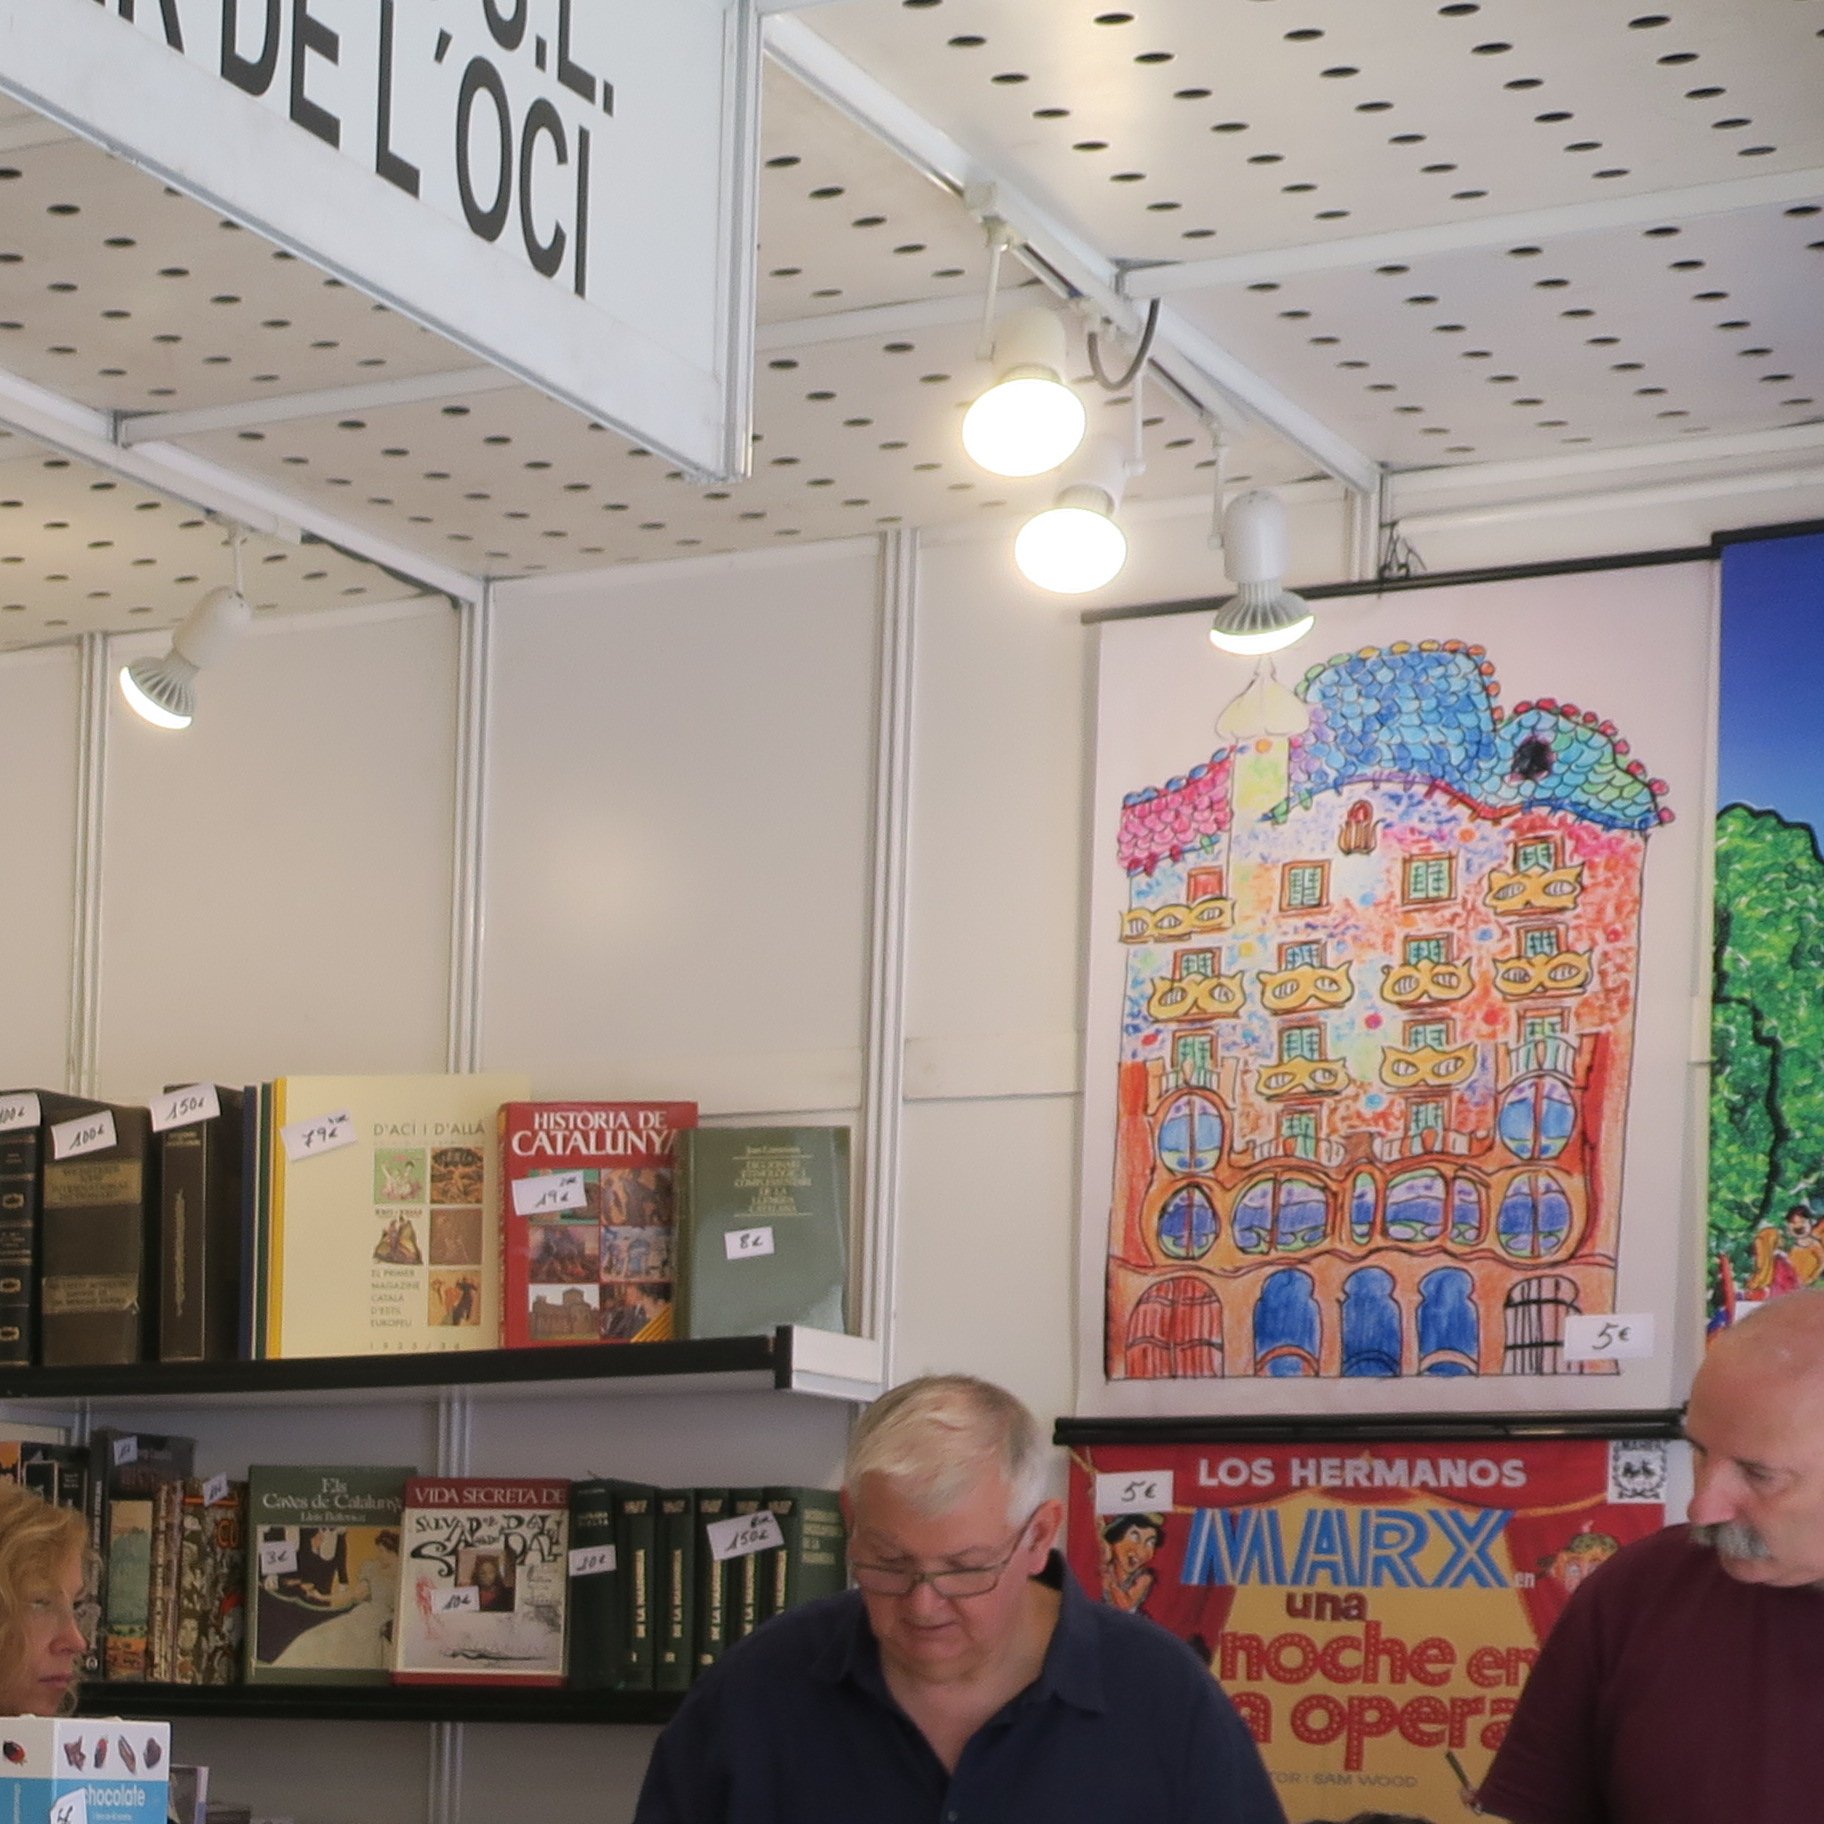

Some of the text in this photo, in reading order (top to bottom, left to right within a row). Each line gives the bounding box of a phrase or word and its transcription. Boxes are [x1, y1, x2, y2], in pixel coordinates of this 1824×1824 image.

[220, 0, 591, 300] DE L'OCI
[637, 1109, 668, 1129] DE
[1591, 1322, 1632, 1351] 5€
[1197, 1457, 1528, 1489] LOS HERMANOS
[413, 1485, 535, 1506] VIDA SECRETA
[1120, 1480, 1158, 1503] 5€
[1179, 1506, 1516, 1588] MARX
[1285, 1590, 1368, 1621] una
[1219, 1621, 1456, 1687] noche
